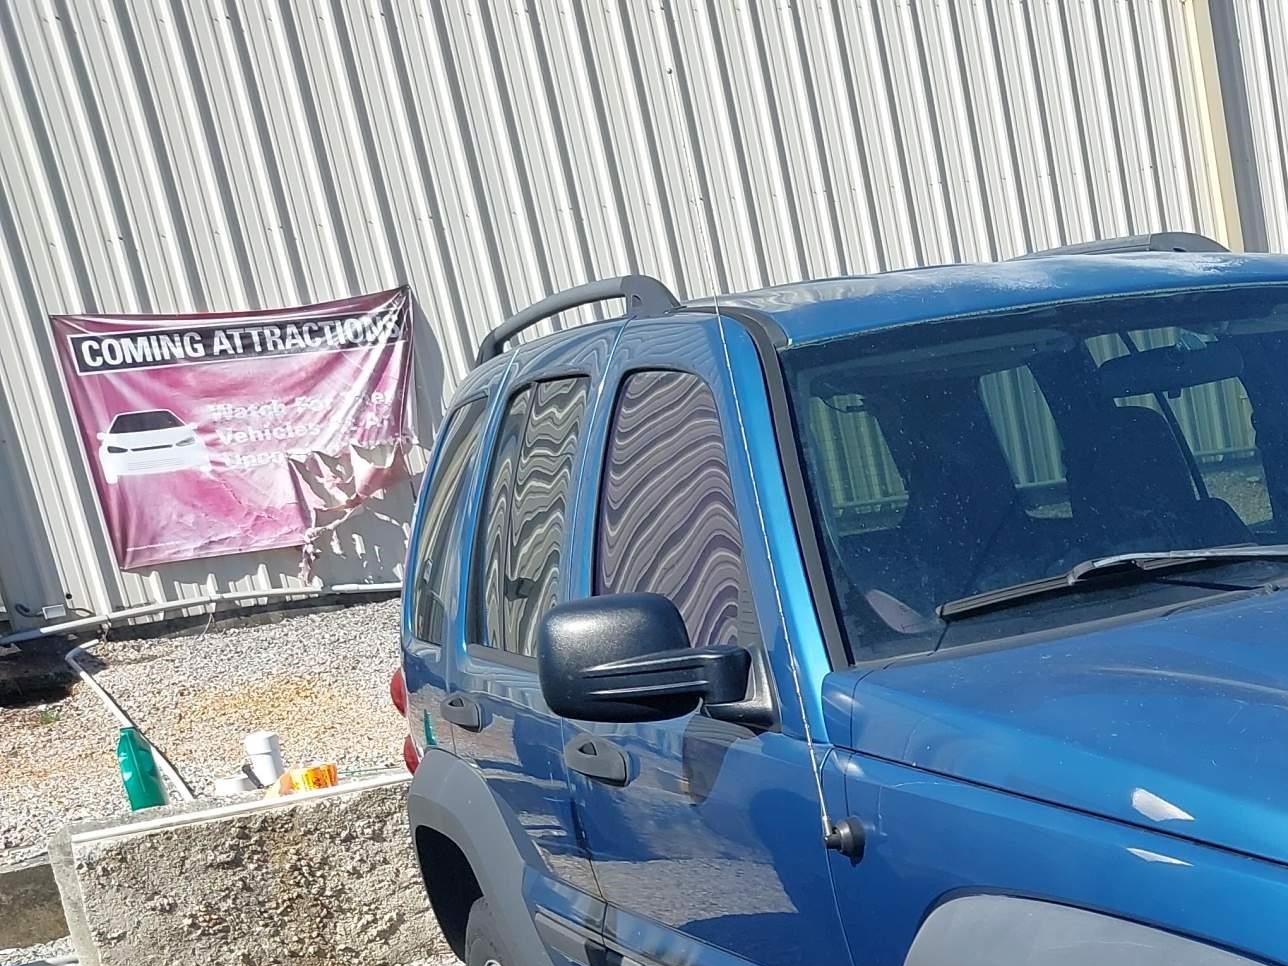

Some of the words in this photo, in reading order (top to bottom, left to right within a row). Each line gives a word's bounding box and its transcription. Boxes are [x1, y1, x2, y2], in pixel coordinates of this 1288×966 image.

[81, 329, 206, 368] COMING
[212, 311, 401, 357] ATTRACTIONS
[215, 421, 322, 446] Vehicles
